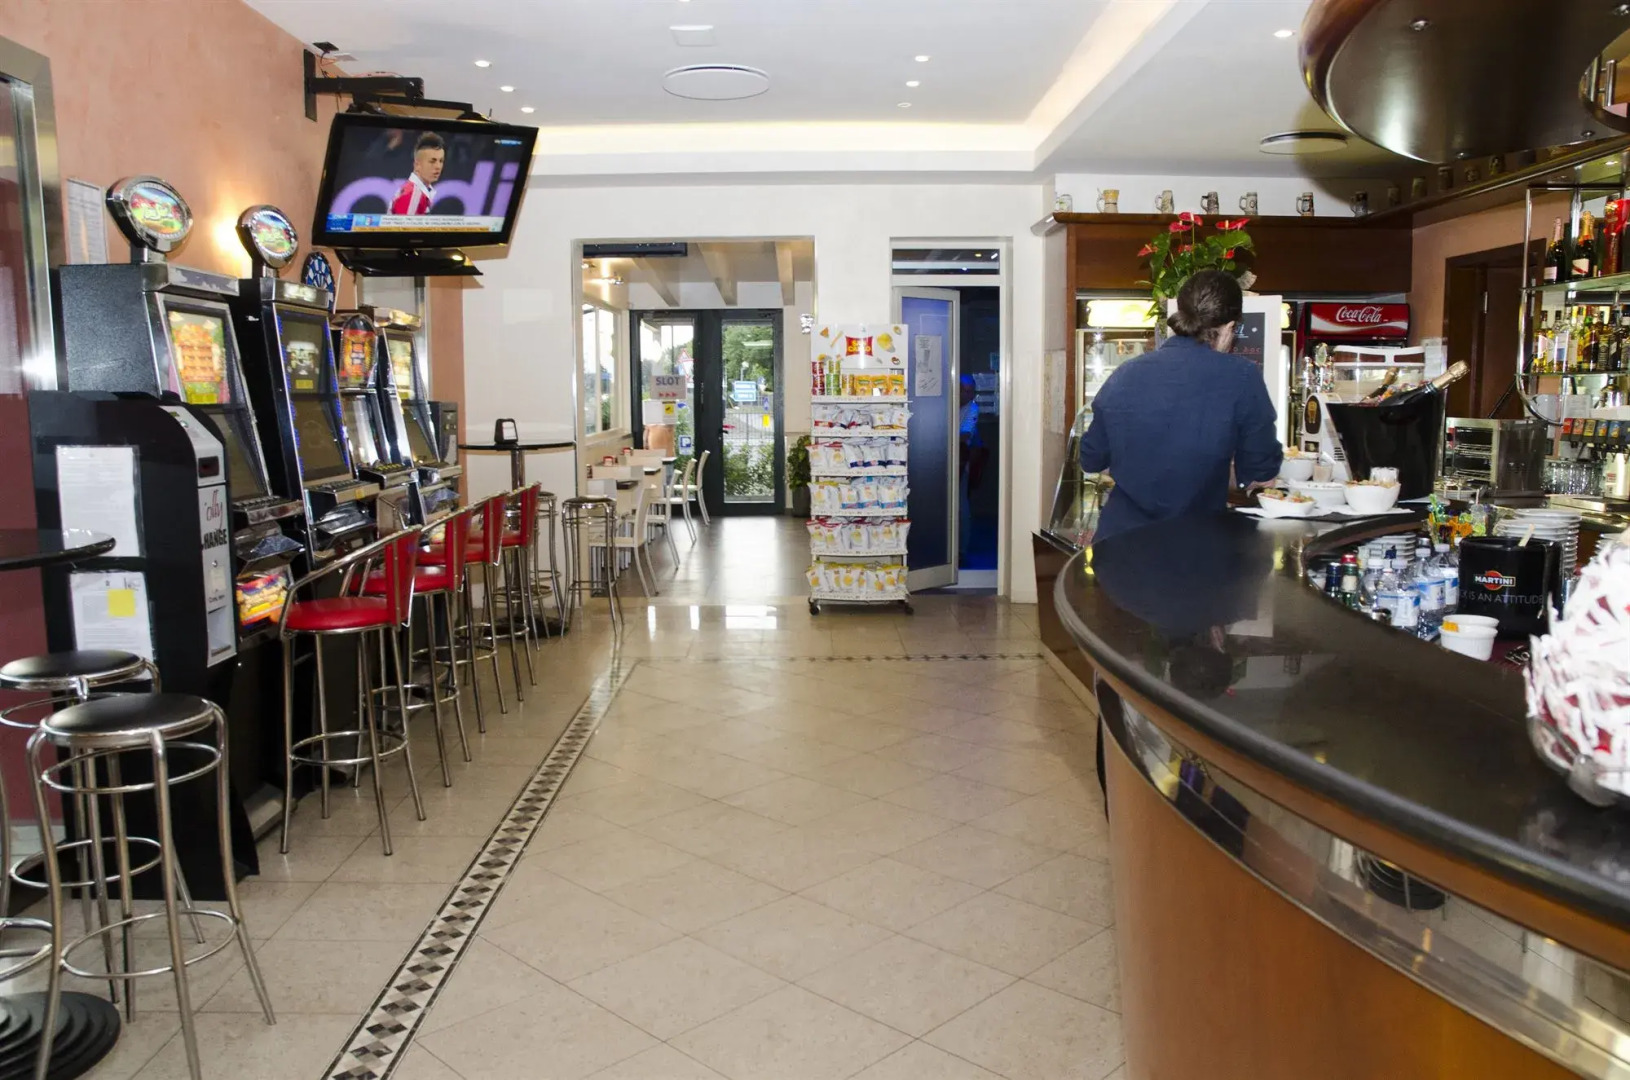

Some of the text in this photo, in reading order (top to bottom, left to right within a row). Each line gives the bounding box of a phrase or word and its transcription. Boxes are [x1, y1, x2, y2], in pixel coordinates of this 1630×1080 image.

[656, 376, 680, 386] SLOT
[203, 529, 228, 550] HANGE
[1475, 576, 1513, 585] MARTINI
[1477, 592, 1492, 602] AN
